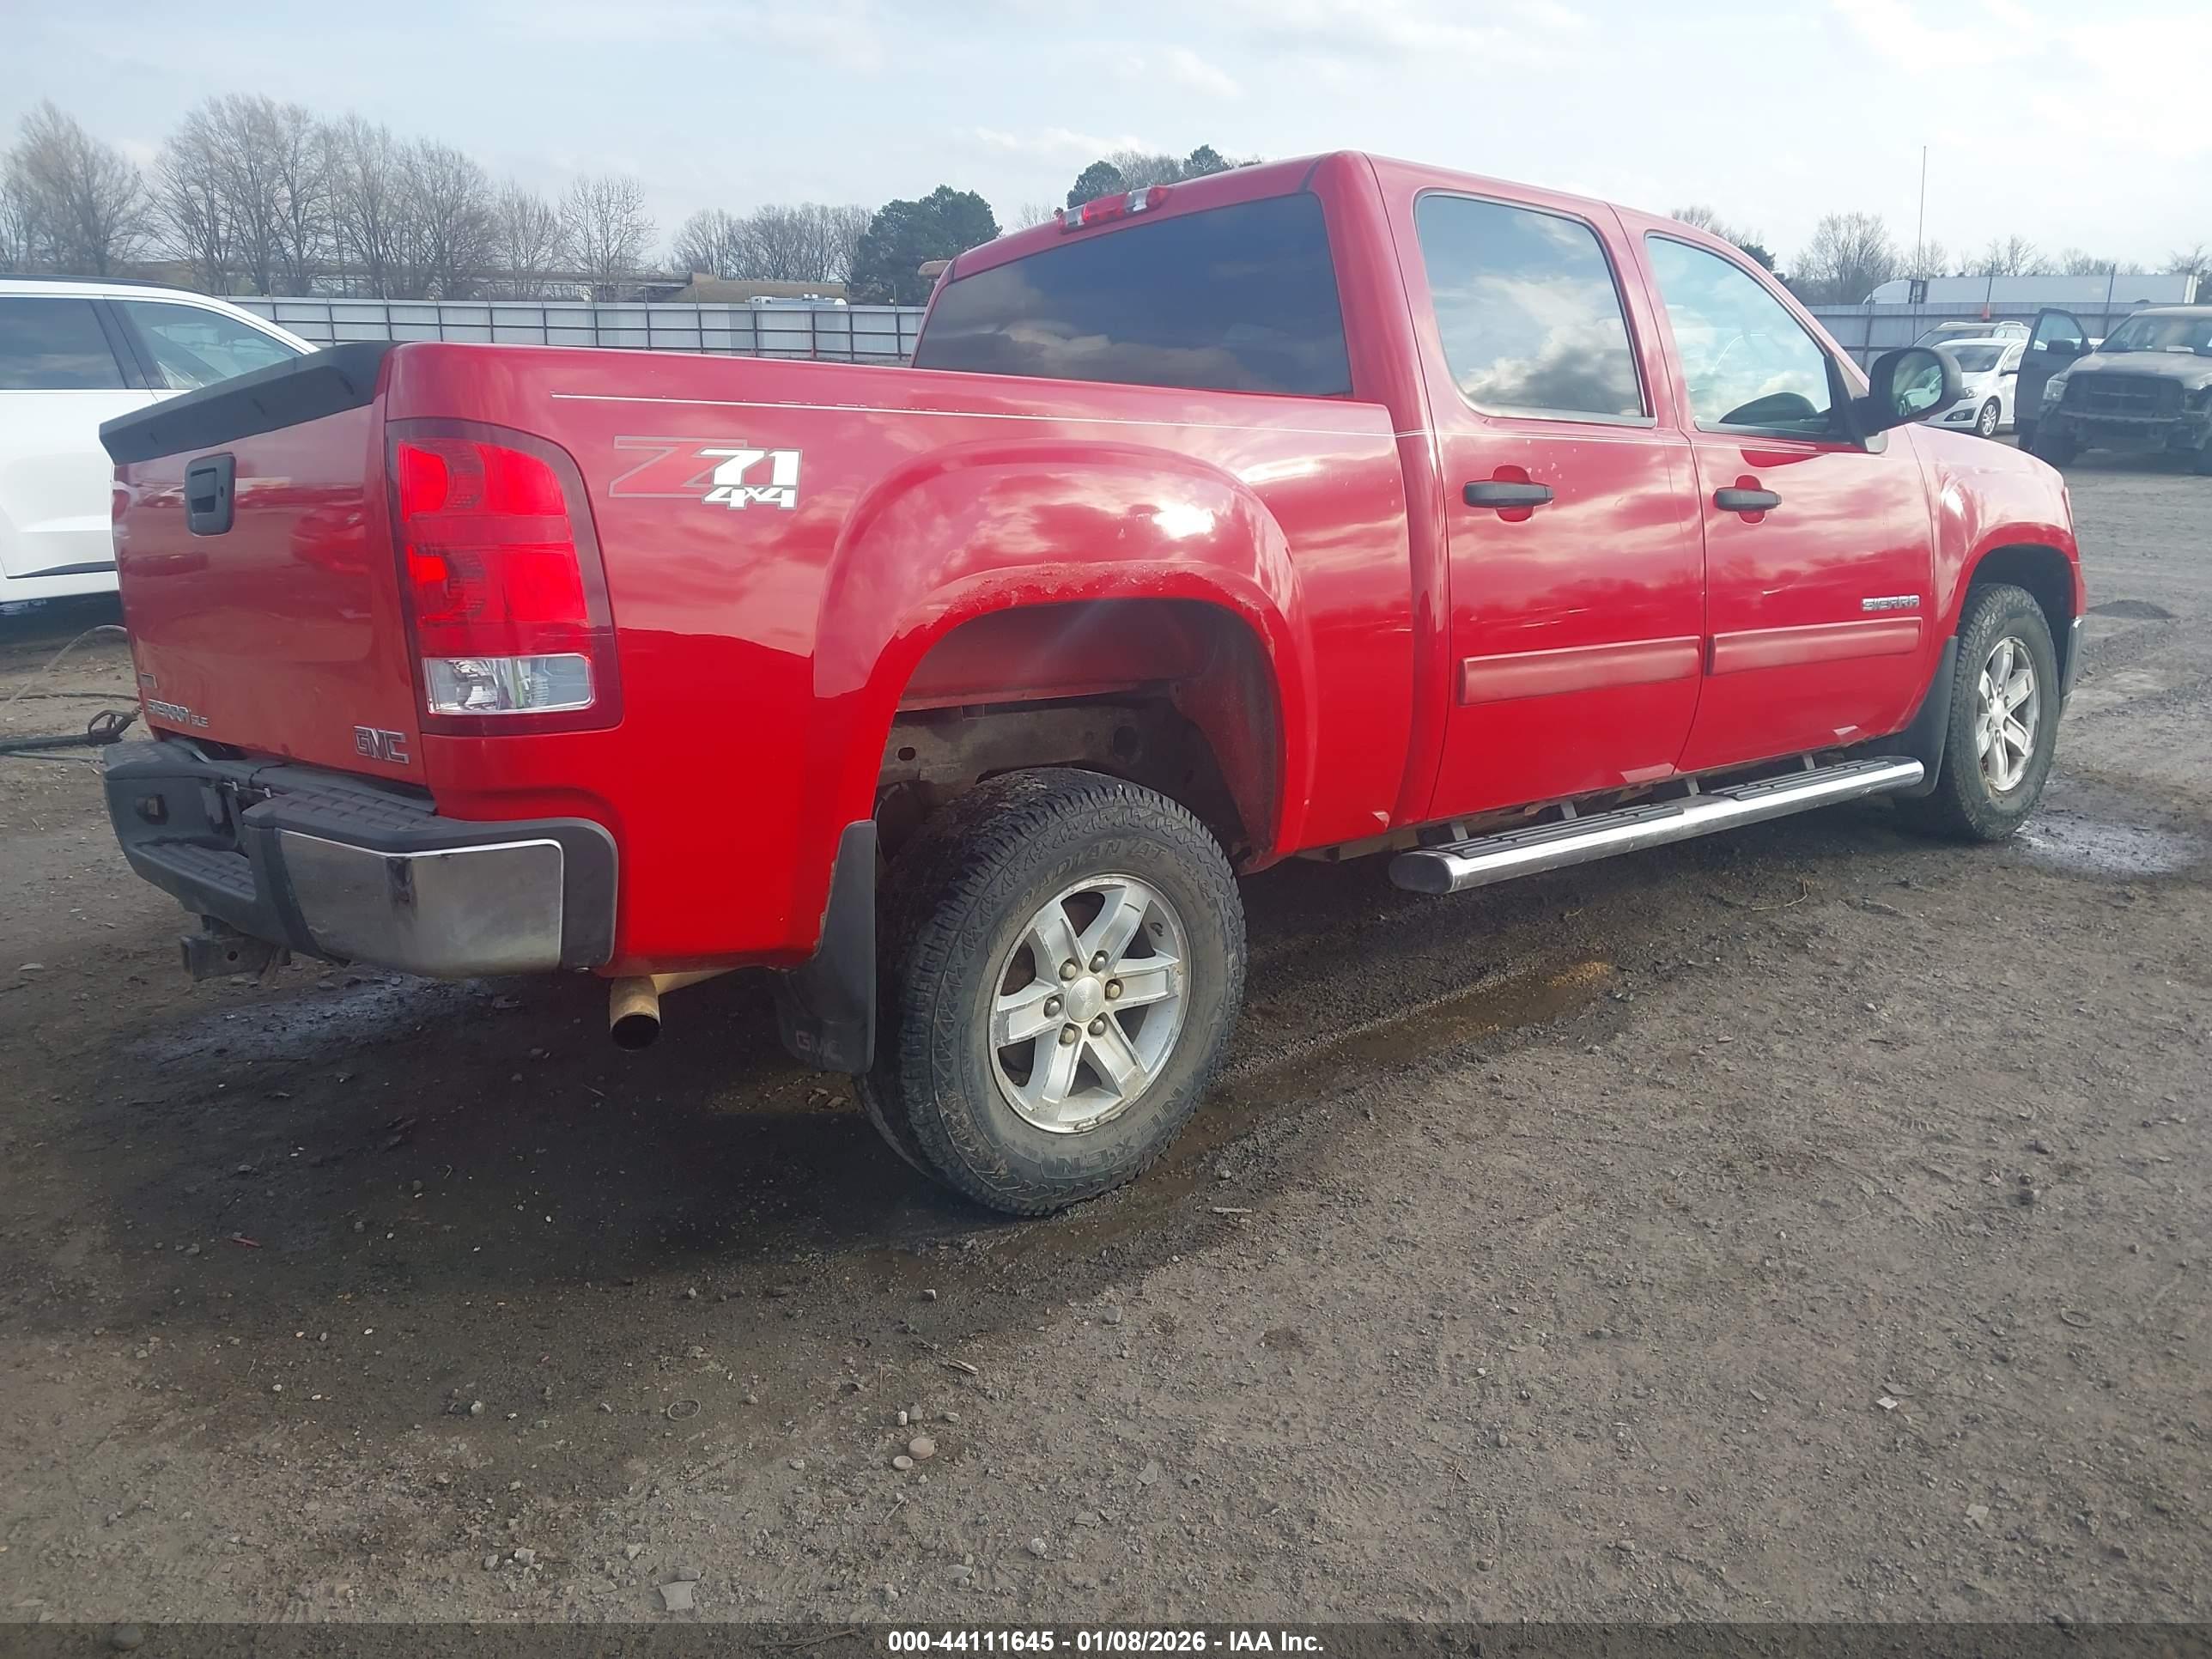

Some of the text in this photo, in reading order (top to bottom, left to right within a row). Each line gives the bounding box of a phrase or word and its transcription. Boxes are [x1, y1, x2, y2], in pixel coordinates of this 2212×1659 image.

[609, 435, 803, 497] Z71
[1862, 595, 1920, 611] SIERRA
[146, 699, 190, 724] SIERRA
[353, 726, 410, 764] GMC
[795, 1030, 843, 1062] GMC
